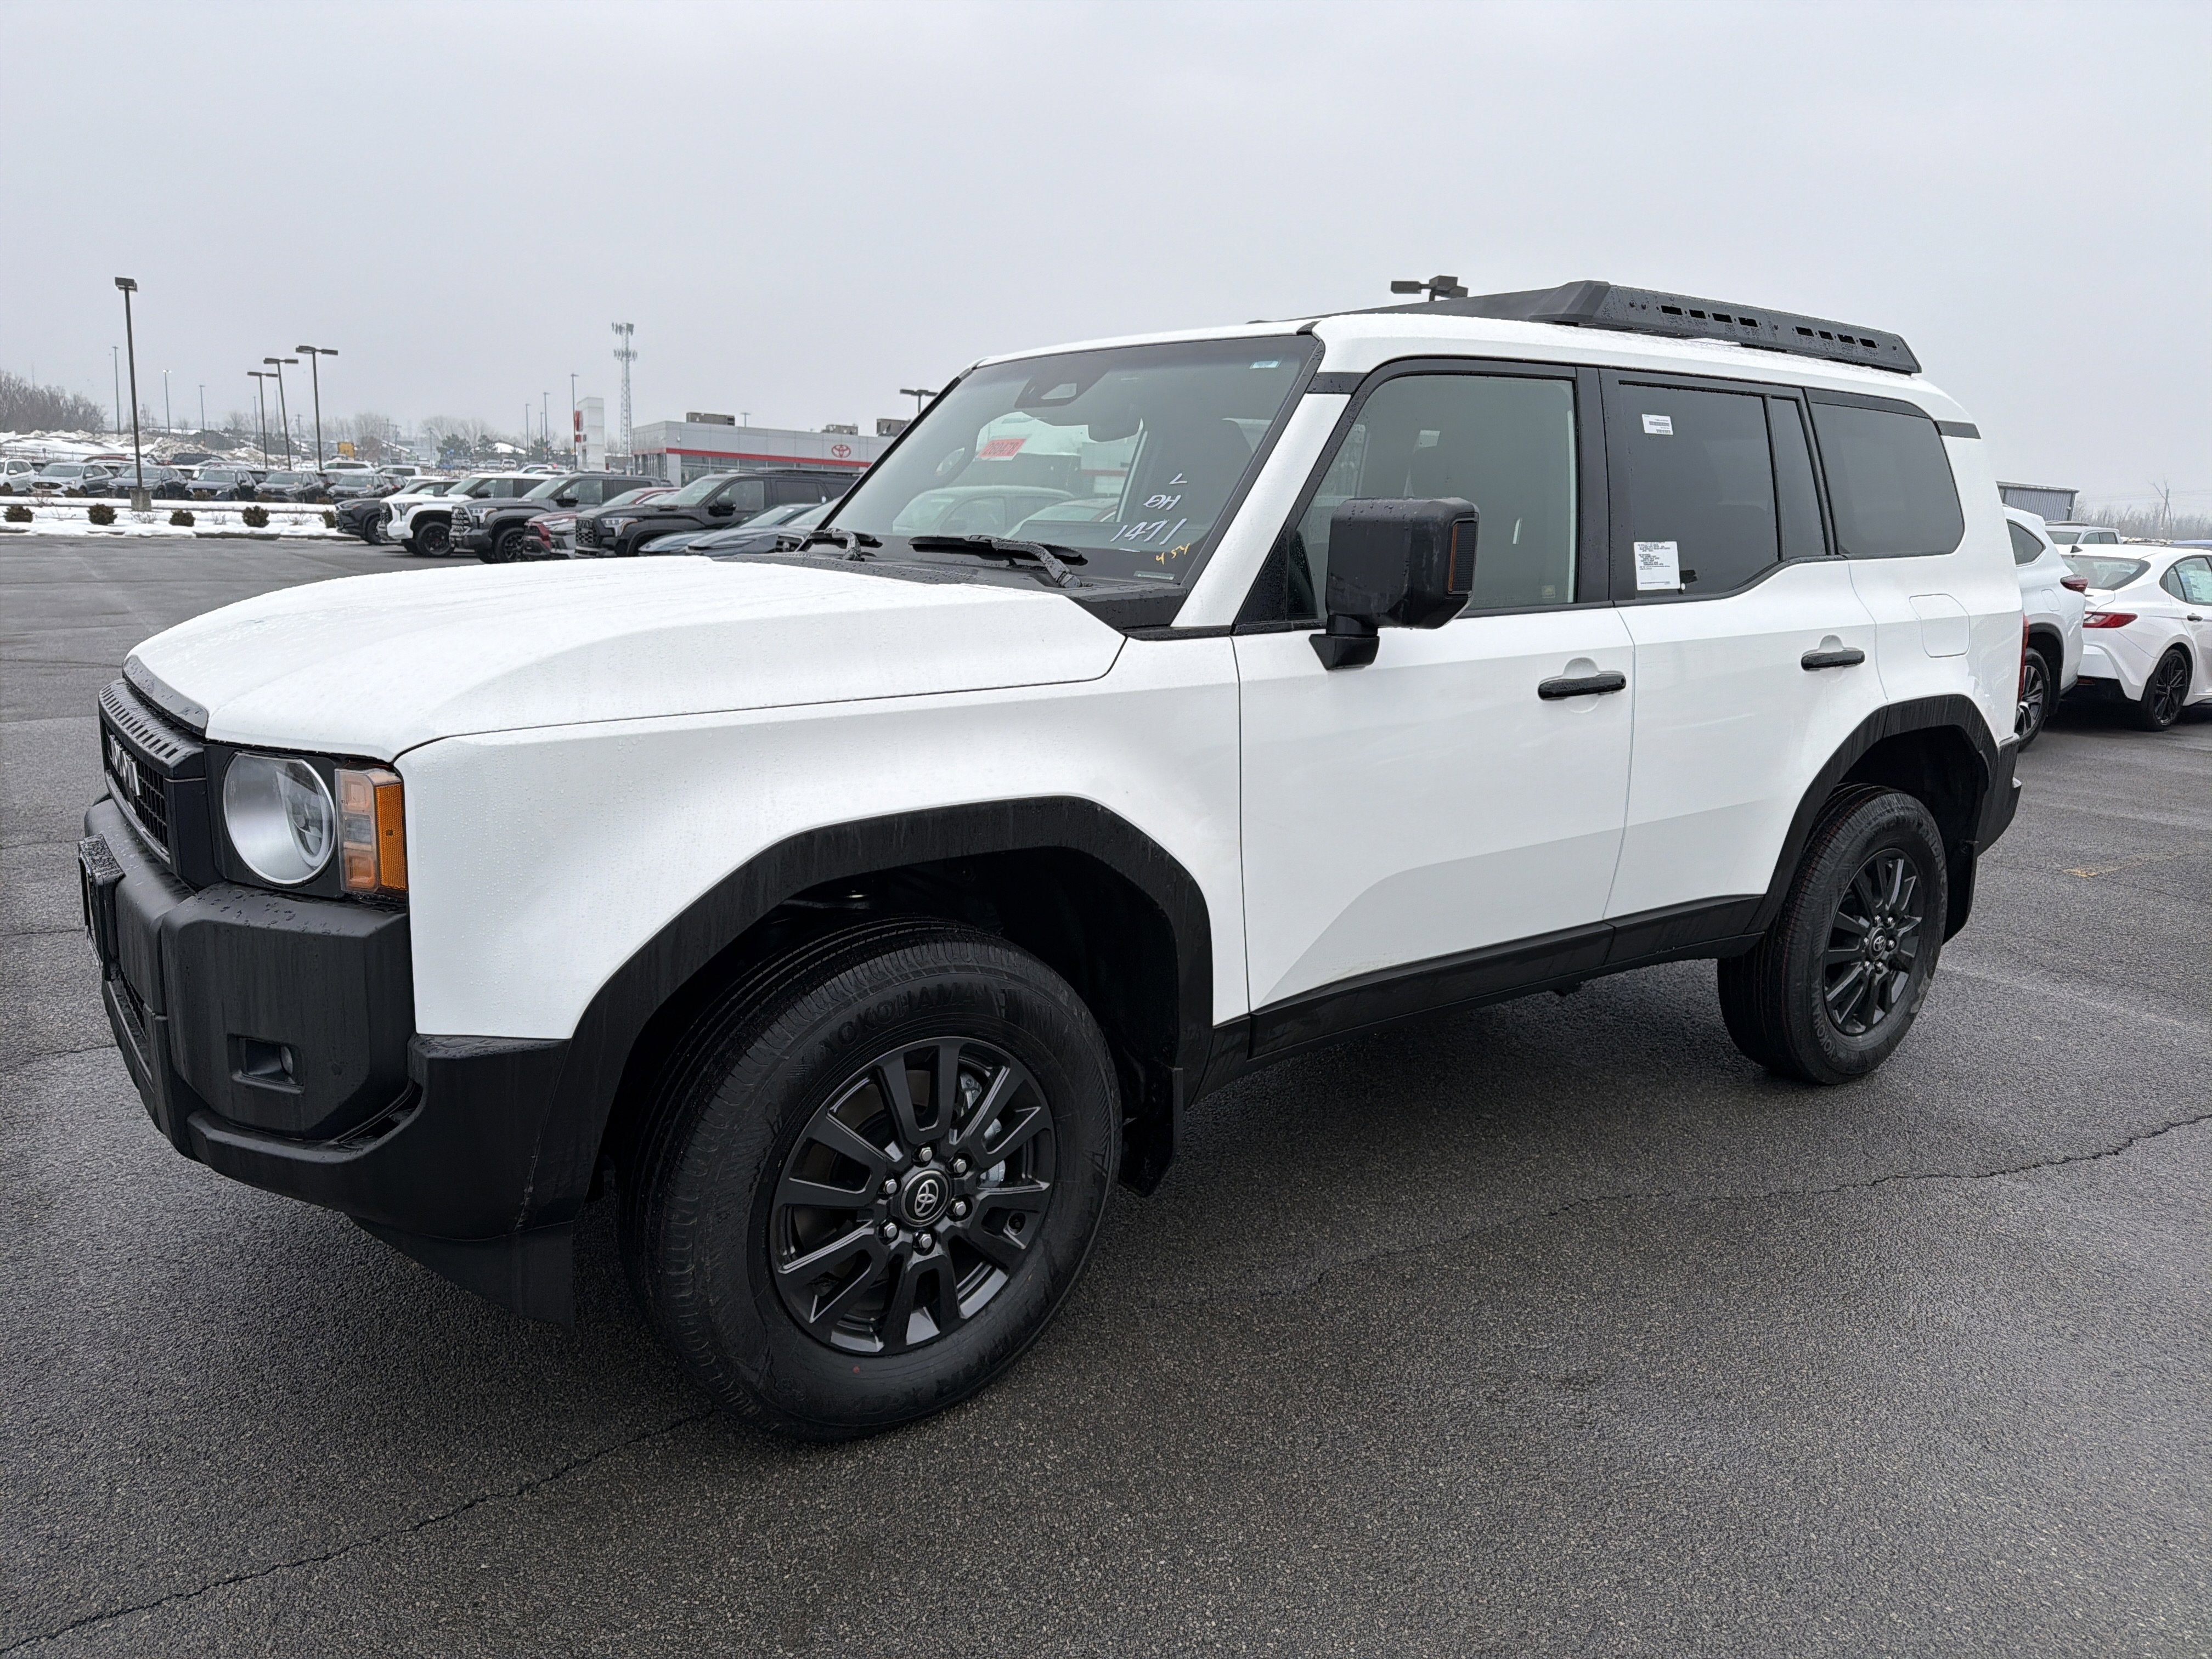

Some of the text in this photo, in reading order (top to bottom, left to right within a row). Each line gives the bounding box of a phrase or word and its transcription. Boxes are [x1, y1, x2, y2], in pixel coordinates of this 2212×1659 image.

[982, 442, 1019, 455] 260478
[1169, 473, 1188, 484] L
[1110, 518, 1187, 545] 1471
[820, 981, 982, 1057] YOKOHAMA
